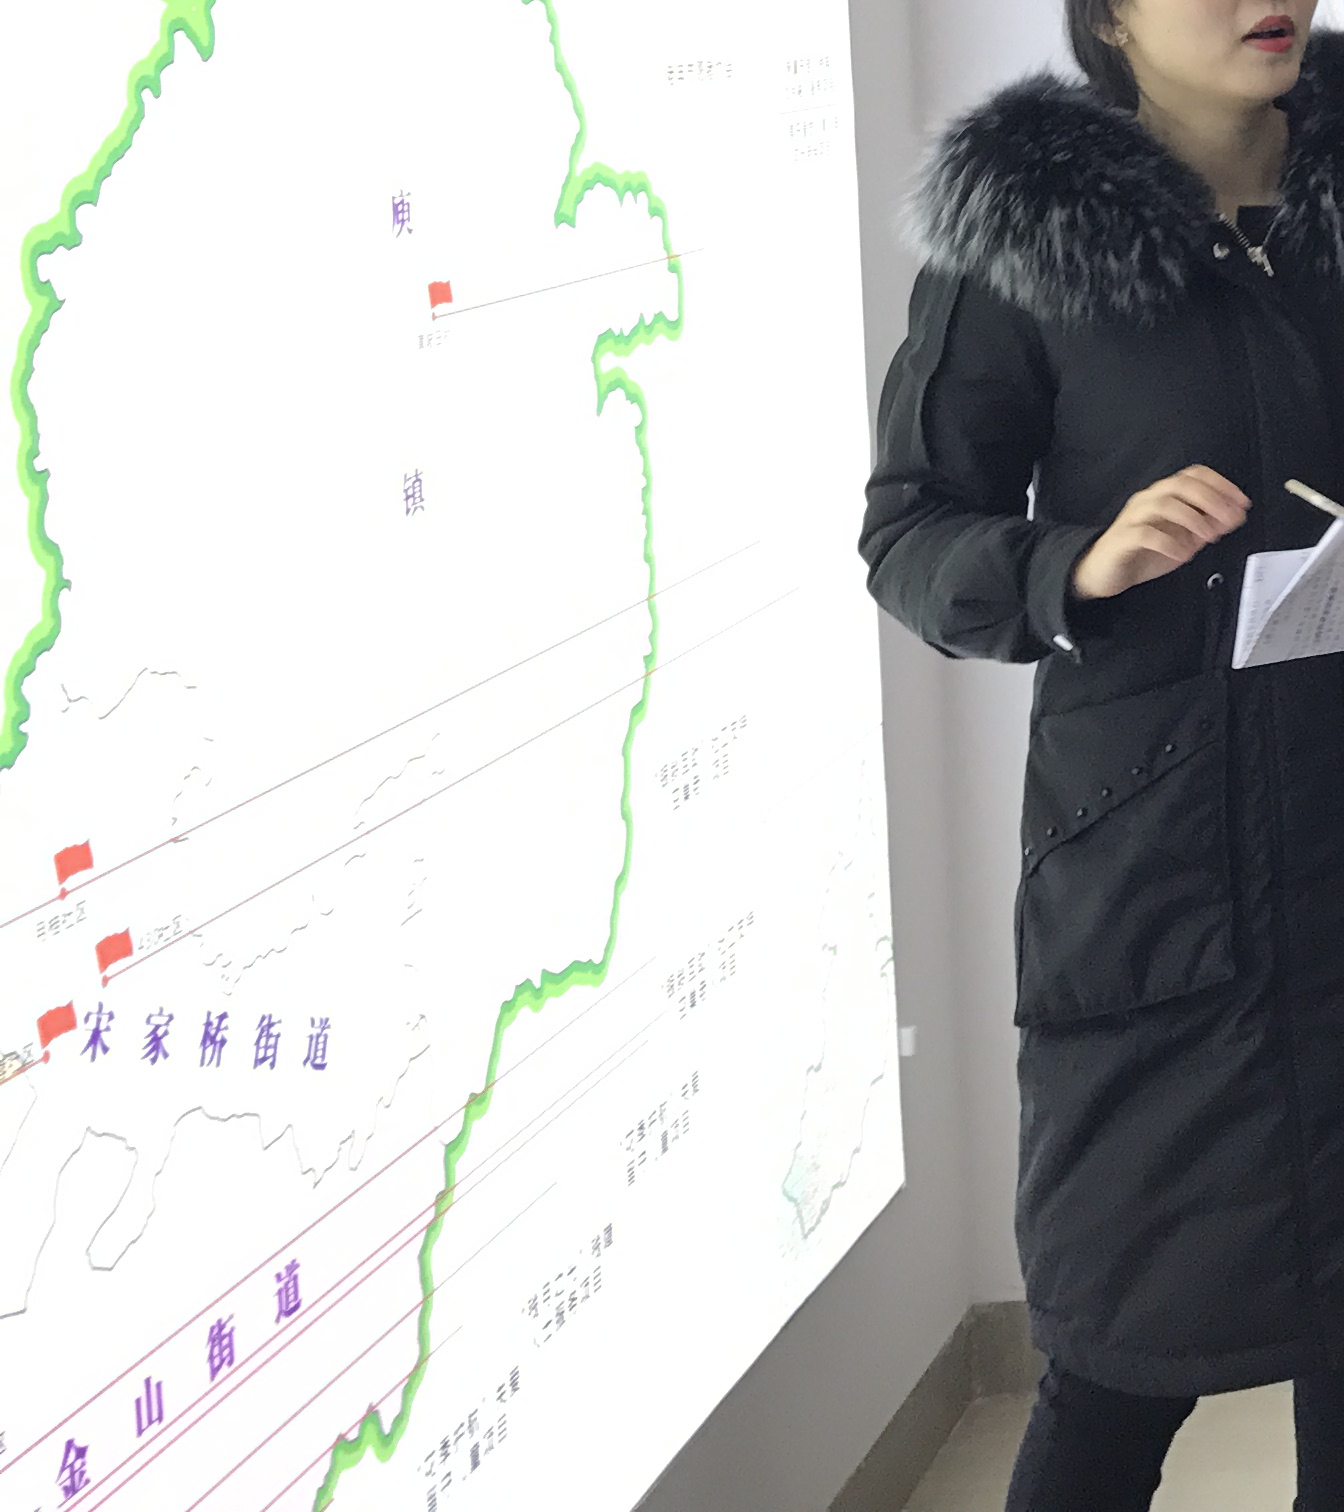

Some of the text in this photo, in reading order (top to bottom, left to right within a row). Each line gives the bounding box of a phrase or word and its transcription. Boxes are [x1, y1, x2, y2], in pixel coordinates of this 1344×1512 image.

[79, 1001, 331, 1071] 宋家桥街道
[56, 1258, 302, 1509] 金山街道
